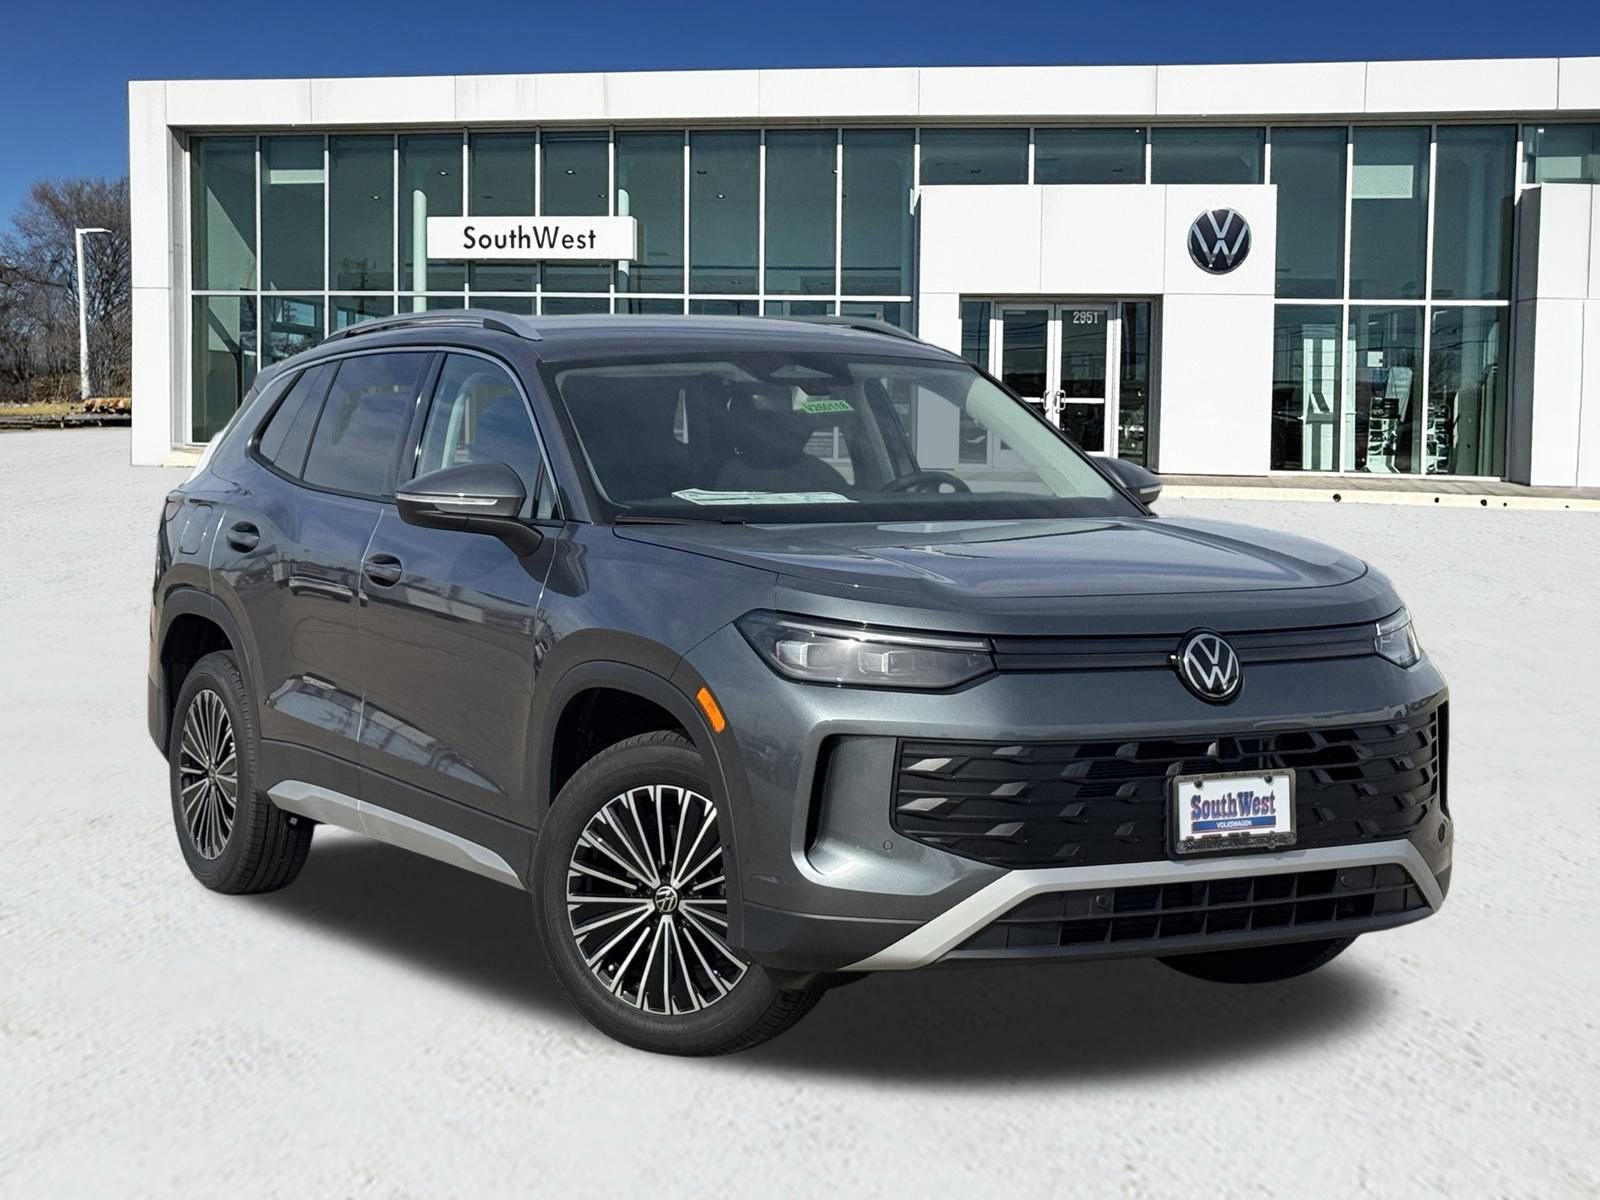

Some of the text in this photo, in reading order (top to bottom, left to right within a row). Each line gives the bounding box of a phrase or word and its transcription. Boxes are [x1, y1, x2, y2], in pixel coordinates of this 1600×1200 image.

[463, 225, 597, 250] SouthWest
[1190, 208, 1250, 270] VW
[1072, 311, 1099, 325] 2951
[1186, 635, 1237, 694] VW
[1190, 789, 1277, 821] SouthWest
[1216, 819, 1252, 829] VOLKSWAGEN
